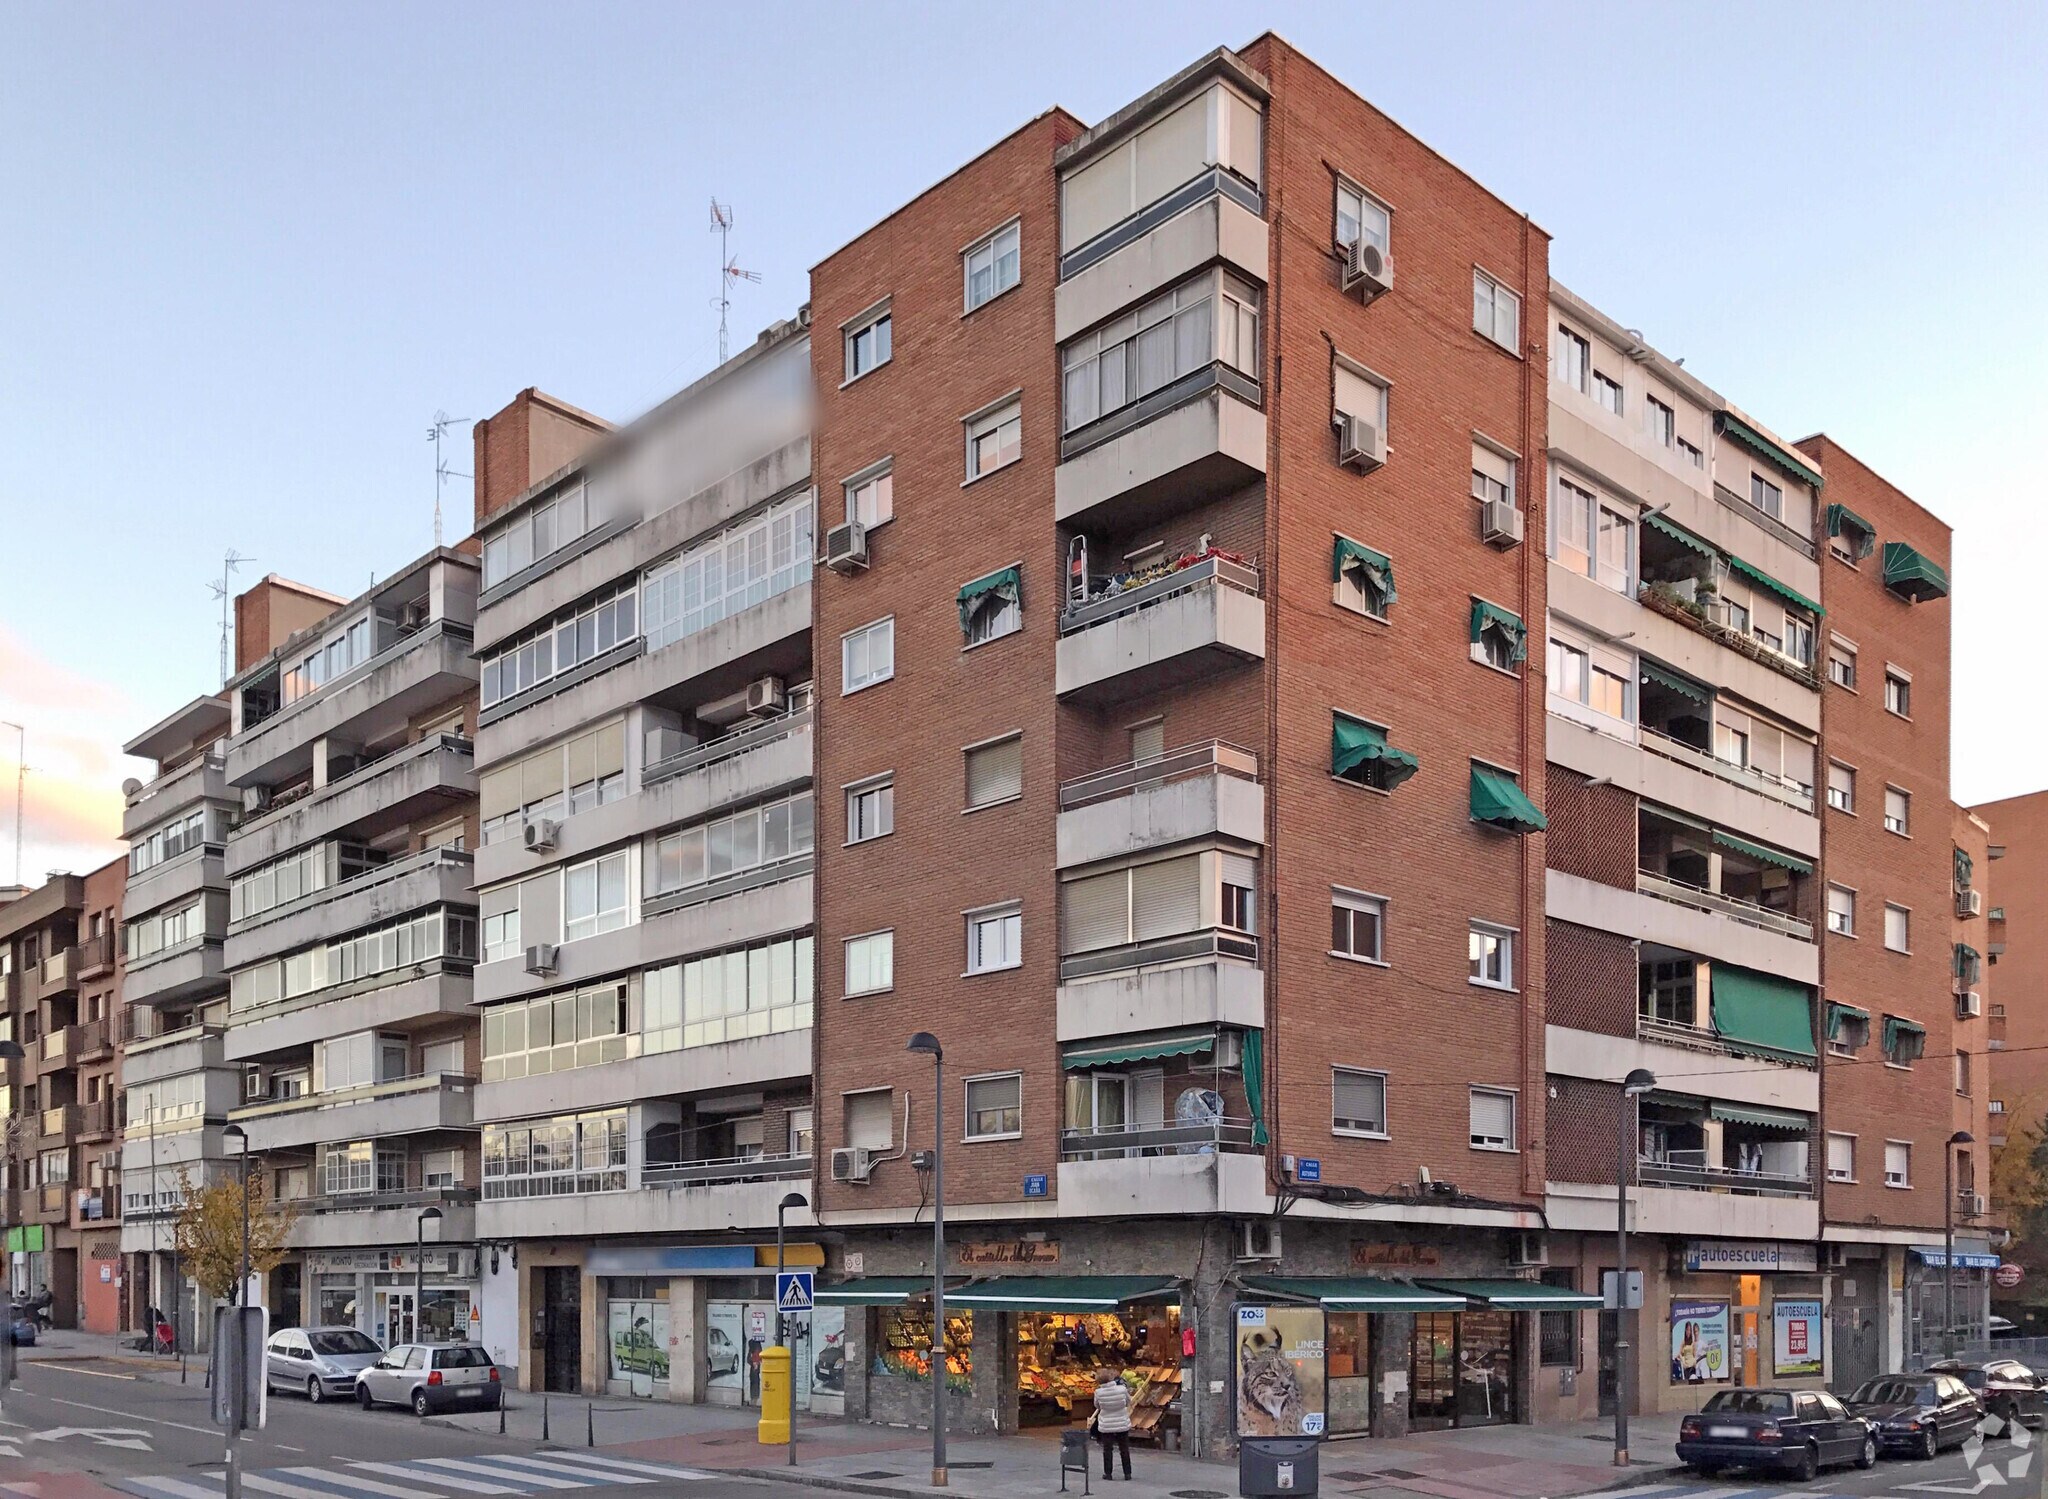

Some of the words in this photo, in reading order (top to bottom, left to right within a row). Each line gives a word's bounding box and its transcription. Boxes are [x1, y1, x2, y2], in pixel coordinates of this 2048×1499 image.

[1701, 1247, 1777, 1264] autoescuela
[1777, 1306, 1818, 1317] AUTOESCUELA
[1296, 1340, 1324, 1348] LINCE
[1306, 1422, 1316, 1431] 17
